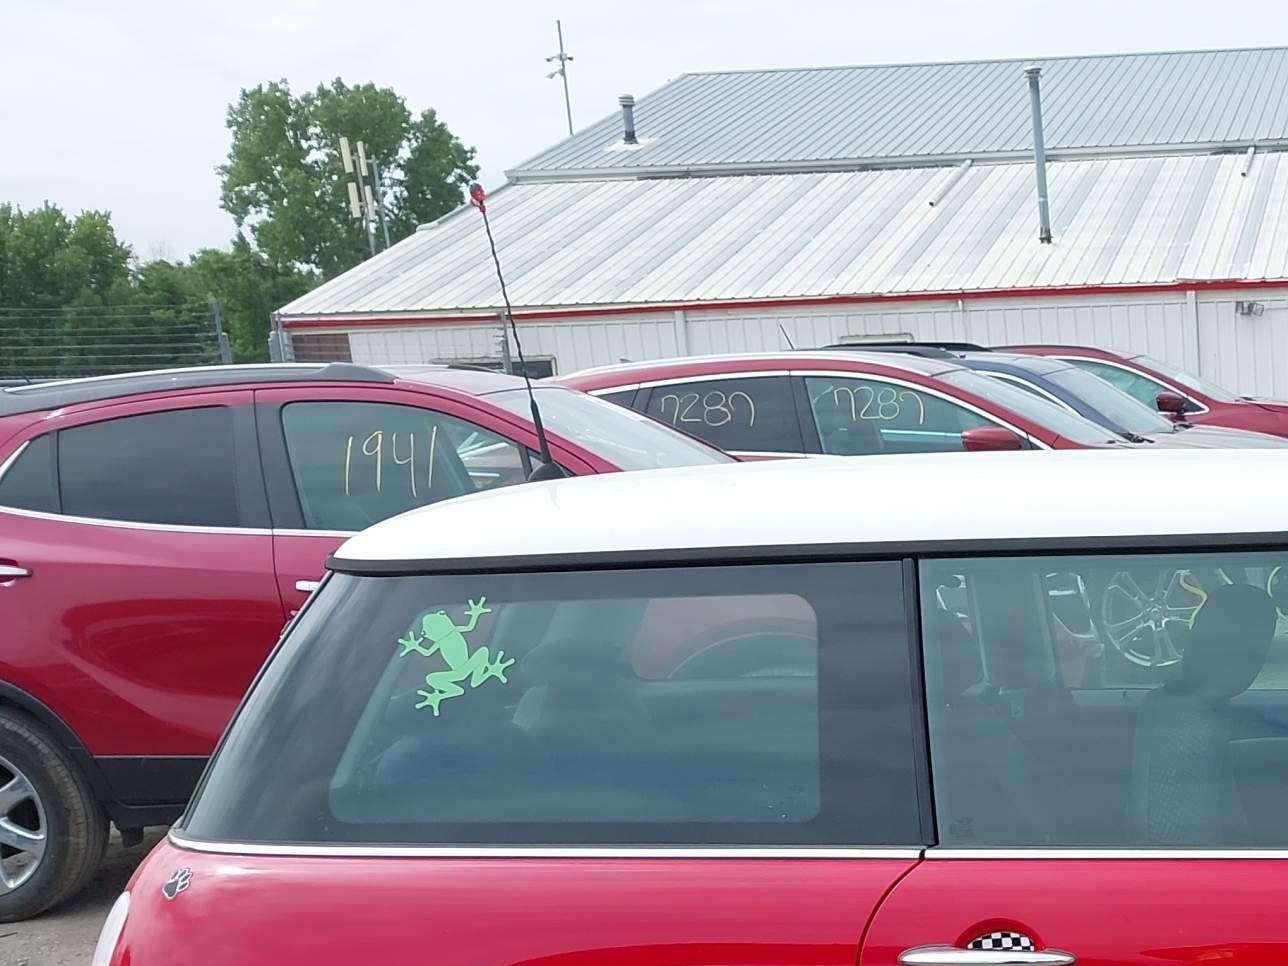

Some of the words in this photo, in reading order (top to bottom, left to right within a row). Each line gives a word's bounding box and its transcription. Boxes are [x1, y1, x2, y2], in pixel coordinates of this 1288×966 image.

[661, 390, 755, 427] 7287
[833, 386, 924, 425] 7287
[345, 425, 438, 498] 1941
